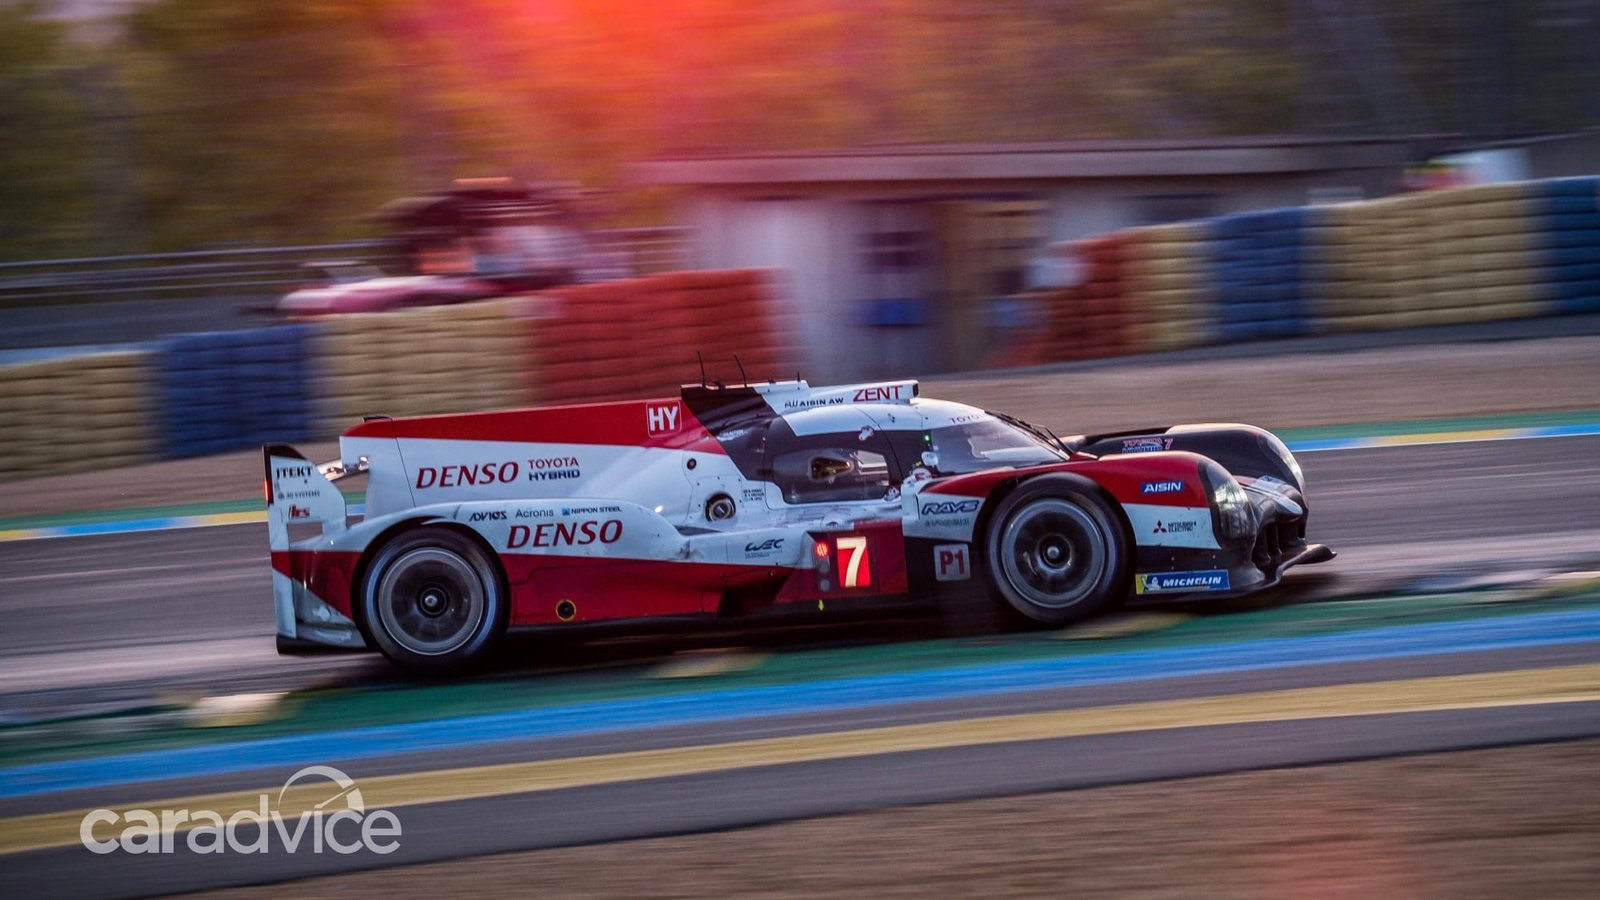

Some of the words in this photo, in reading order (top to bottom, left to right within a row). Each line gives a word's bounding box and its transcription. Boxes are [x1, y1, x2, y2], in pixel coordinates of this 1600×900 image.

[853, 385, 903, 402] ZENT
[800, 399, 826, 407] AISIN
[829, 397, 844, 405] AW
[648, 406, 679, 431] HY
[1164, 438, 1174, 450] 7
[528, 457, 579, 470] TOYOTA
[277, 466, 313, 479] JTEKT
[416, 461, 519, 489] DENSO
[528, 469, 581, 481] HYBRID
[1144, 482, 1182, 493] AISIN
[515, 508, 554, 519] Acronis
[921, 499, 979, 515] RAYS
[507, 519, 623, 549] DENSO
[745, 539, 785, 551] WEC
[836, 536, 867, 587] 7
[940, 549, 966, 575] P1
[1162, 576, 1222, 588] MICHELIN
